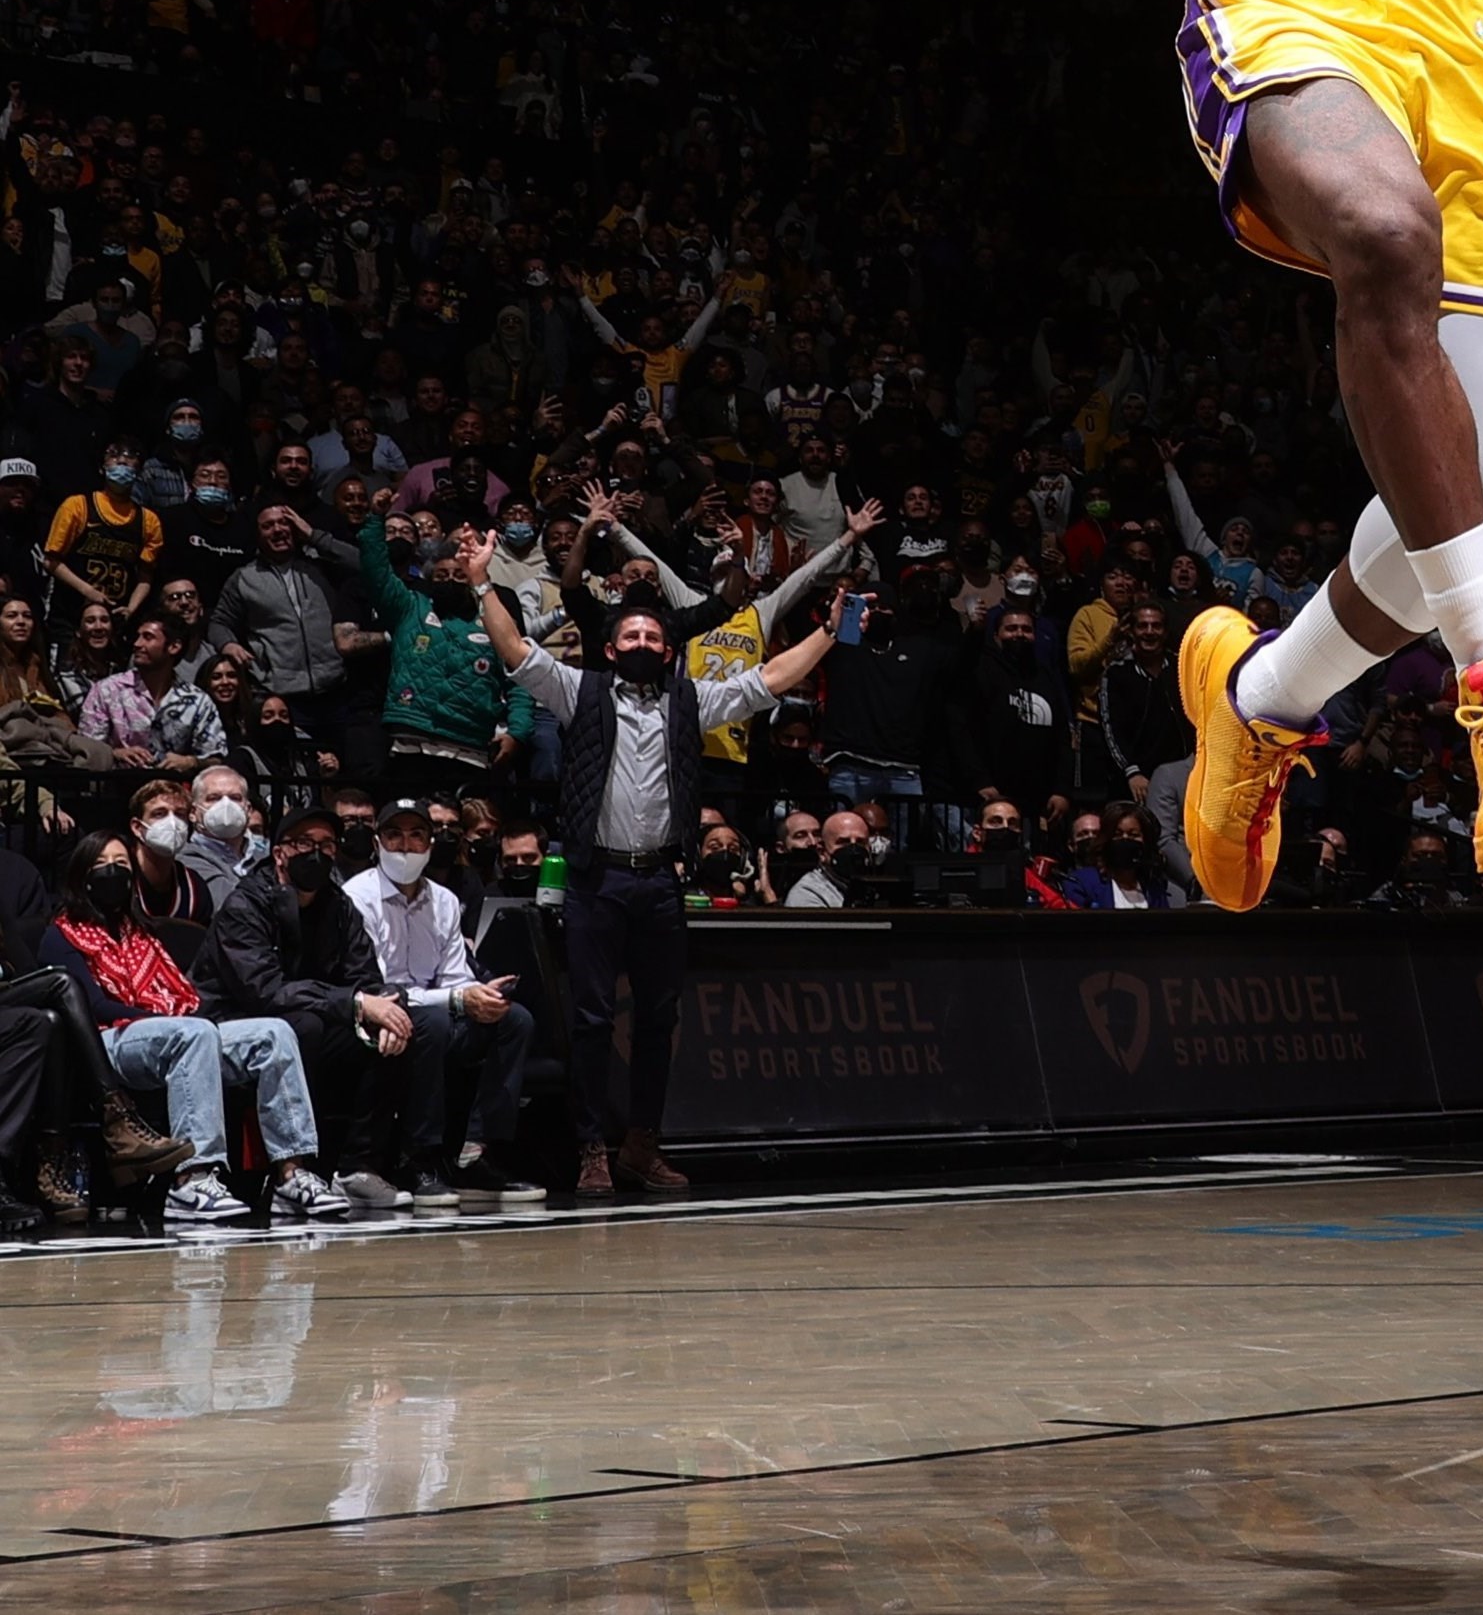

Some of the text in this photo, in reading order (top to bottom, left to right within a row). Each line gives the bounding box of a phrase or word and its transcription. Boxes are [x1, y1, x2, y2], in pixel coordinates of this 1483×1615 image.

[187, 534, 245, 557] Champion
[698, 630, 758, 655] LAKERS
[697, 980, 936, 1035] FANDUEL
[1161, 975, 1360, 1026] FANDUEL
[707, 1042, 944, 1081] SPORTSBOOK
[1173, 1033, 1367, 1067] SPORTSBOOK
